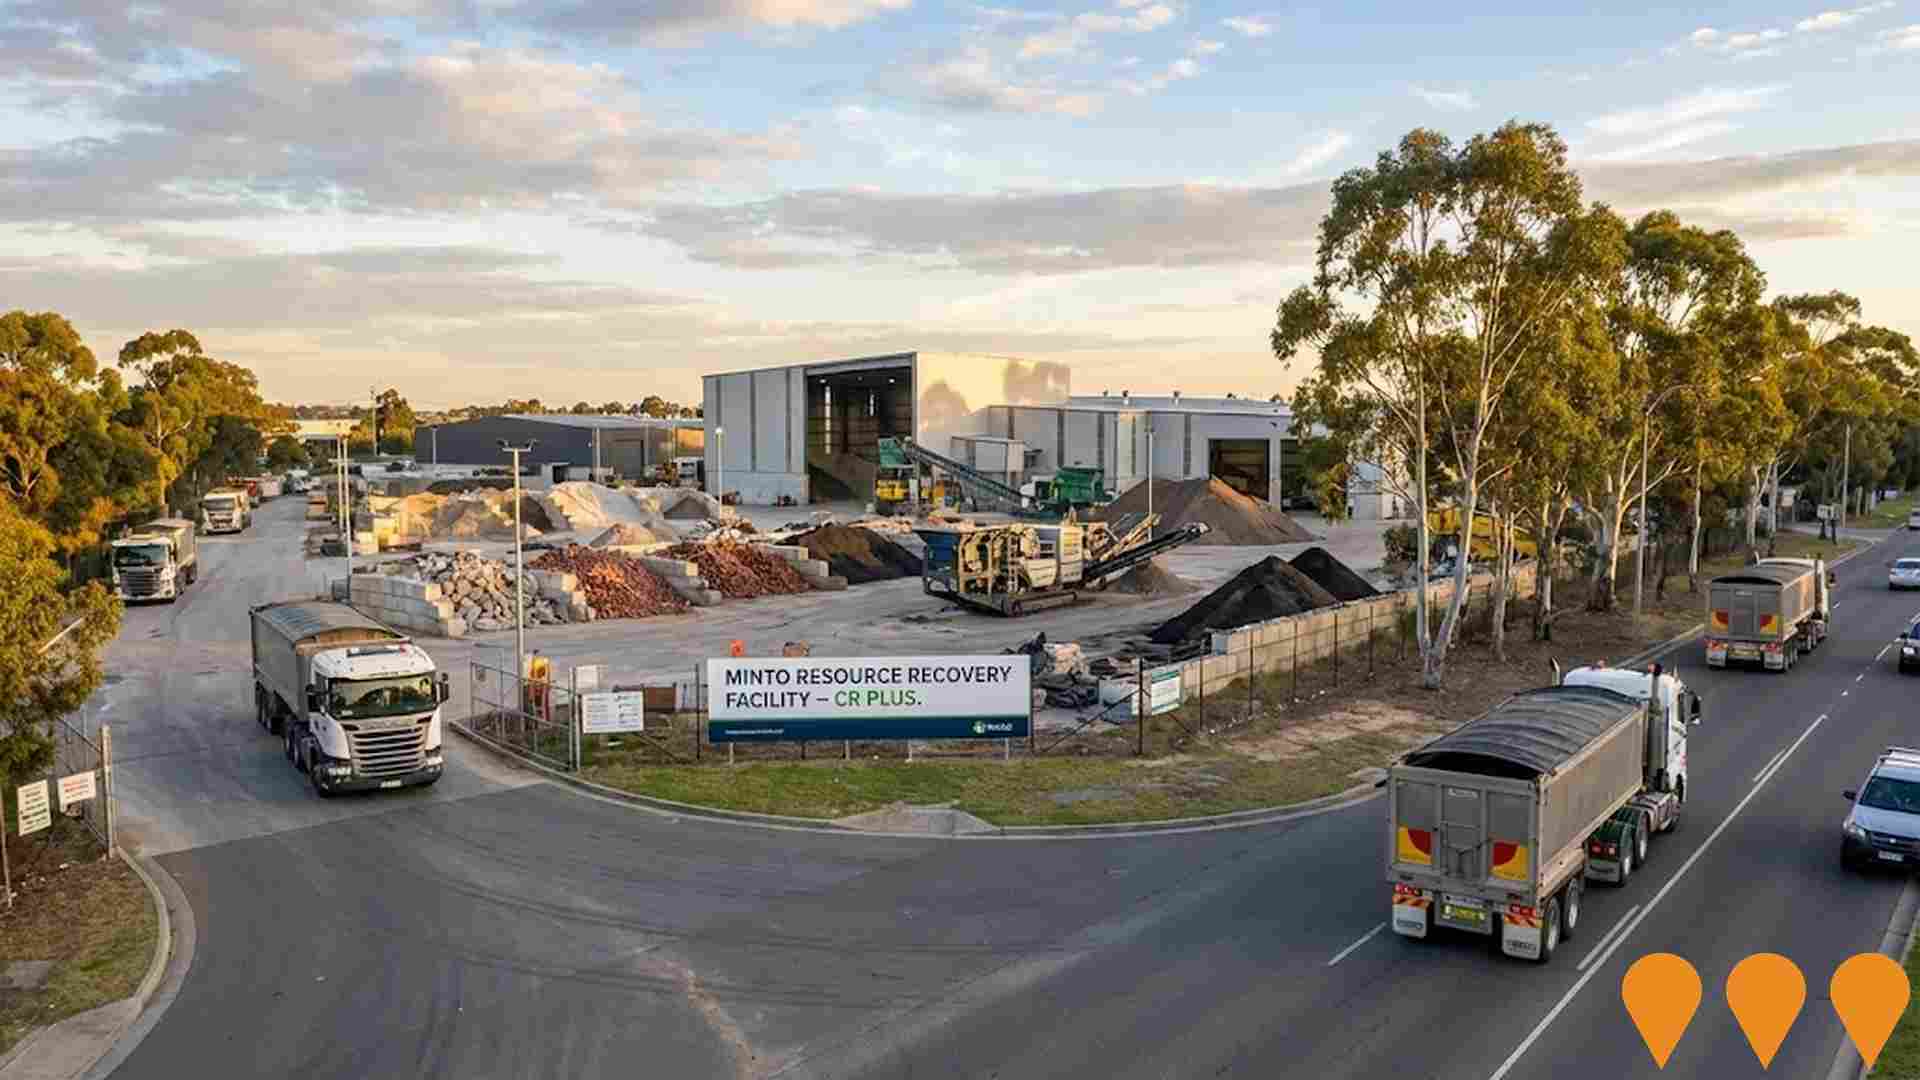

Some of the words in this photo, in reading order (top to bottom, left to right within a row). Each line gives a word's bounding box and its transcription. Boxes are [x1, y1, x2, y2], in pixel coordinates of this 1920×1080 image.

[725, 668, 790, 685] MINTO
[796, 667, 902, 684] RESOURCE
[908, 665, 1012, 684] RECOVERY
[725, 691, 810, 708] FACILITY
[834, 690, 860, 707] CR
[866, 689, 922, 706] PLUS.
